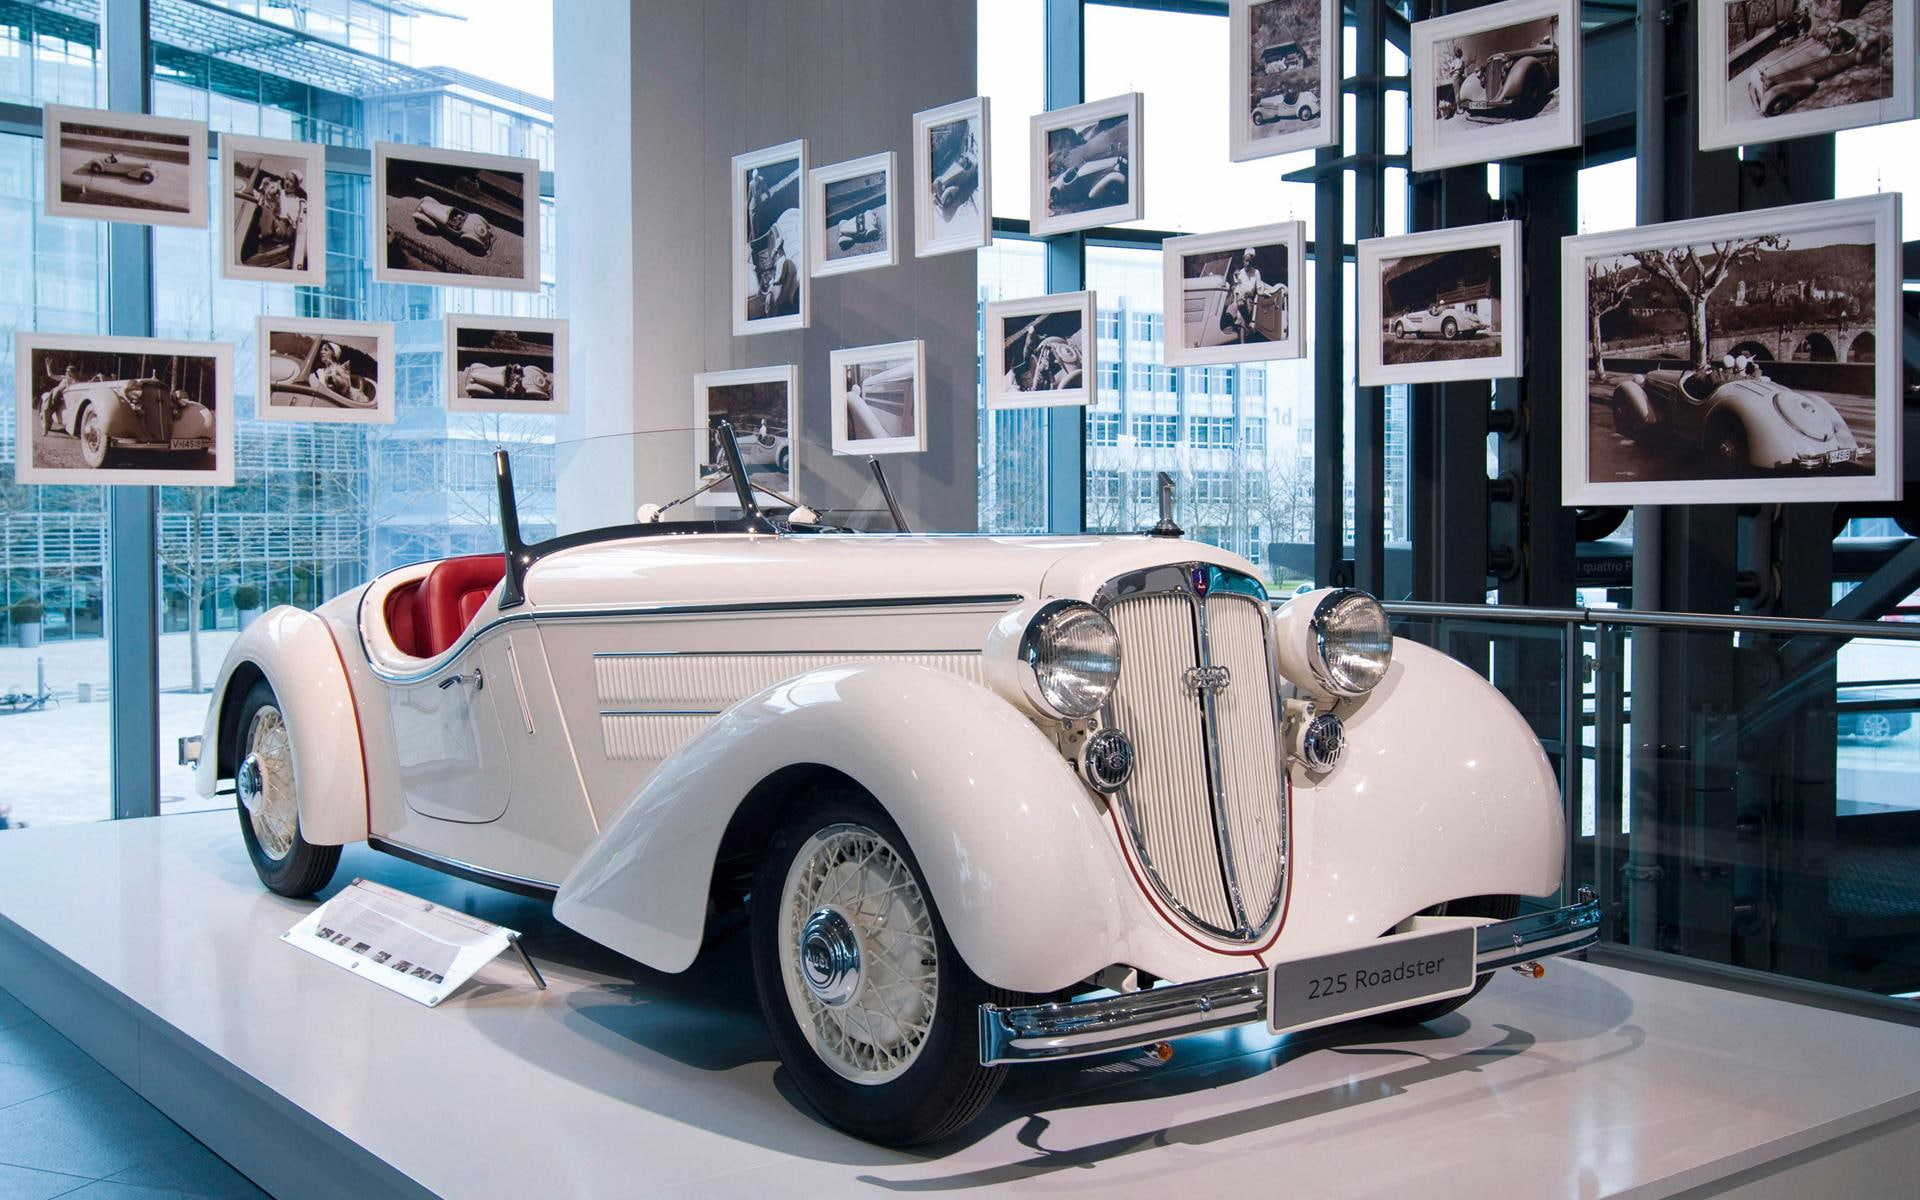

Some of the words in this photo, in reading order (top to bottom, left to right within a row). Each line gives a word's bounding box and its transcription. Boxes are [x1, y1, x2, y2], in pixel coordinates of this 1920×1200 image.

[1583, 561, 1623, 575] quattro
[1308, 973, 1348, 1000] 225
[1355, 958, 1445, 989] Roadster
